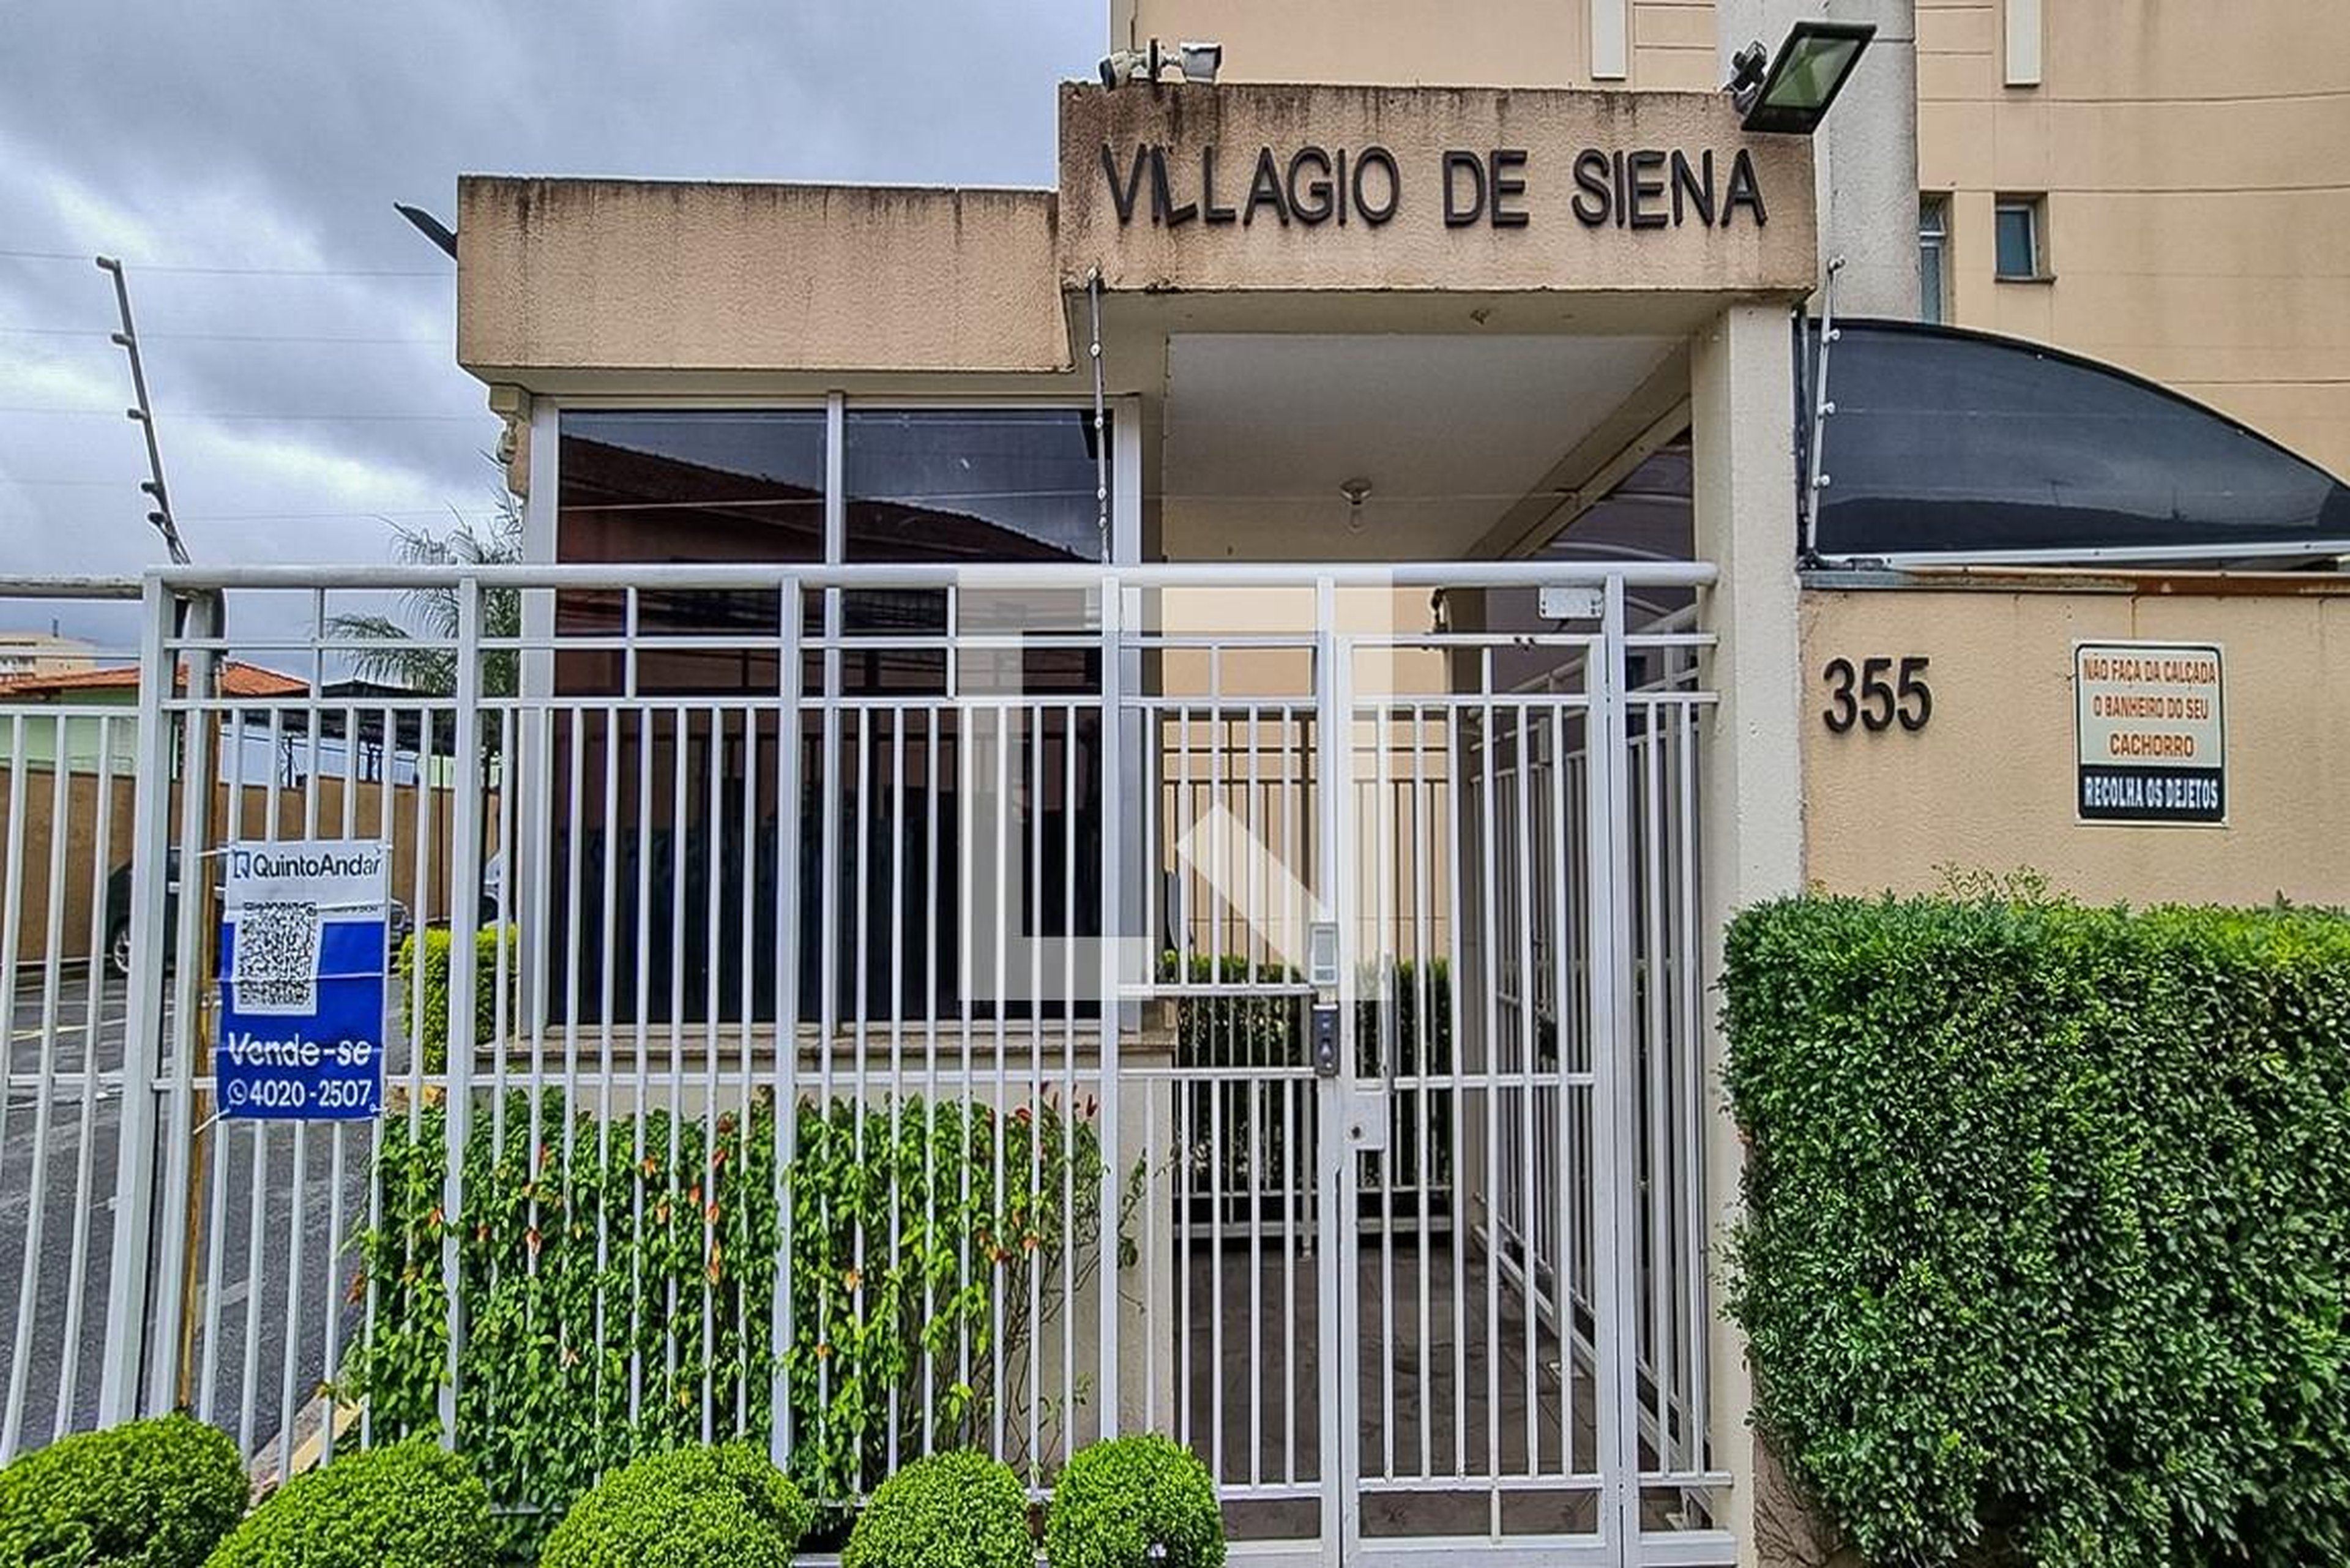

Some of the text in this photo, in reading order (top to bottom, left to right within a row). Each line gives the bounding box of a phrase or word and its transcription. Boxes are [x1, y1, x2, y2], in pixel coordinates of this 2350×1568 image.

[1102, 144, 1768, 230] VILLAGIO DE SIENA
[2084, 653, 2216, 690] NÃO FAÇA DA CALÇADA
[1823, 657, 1933, 733] 355
[2094, 696, 2209, 720] O BANHEIRO DO SEU
[2111, 734, 2195, 757] CACHORRO
[2084, 777, 2218, 809] RECOLHA OS DEJETOS
[253, 853, 381, 878] QuintoAndar
[228, 1032, 371, 1066] Vende-se
